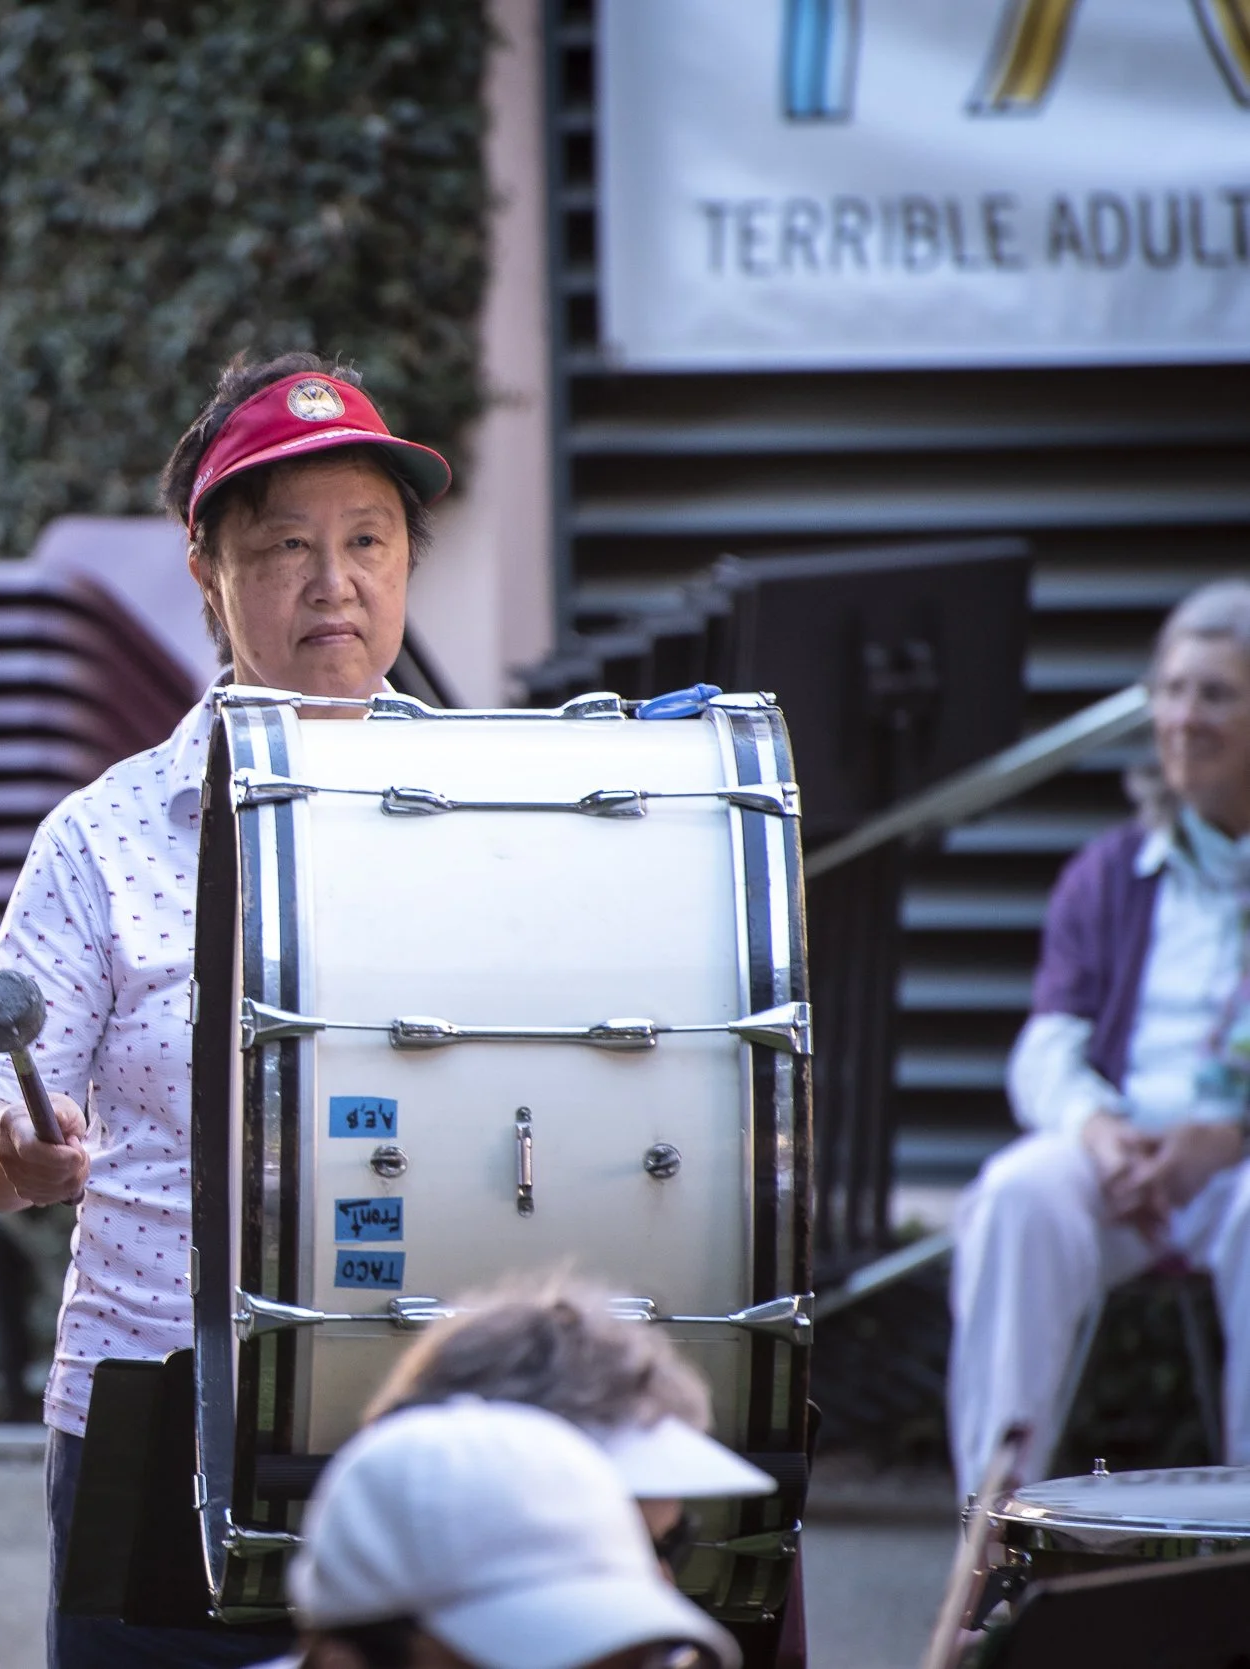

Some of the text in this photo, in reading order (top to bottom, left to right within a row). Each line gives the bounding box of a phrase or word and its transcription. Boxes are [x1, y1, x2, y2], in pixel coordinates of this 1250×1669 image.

[698, 188, 1250, 276] TERRIBLE ADULT
[342, 1260, 399, 1283] TACO
